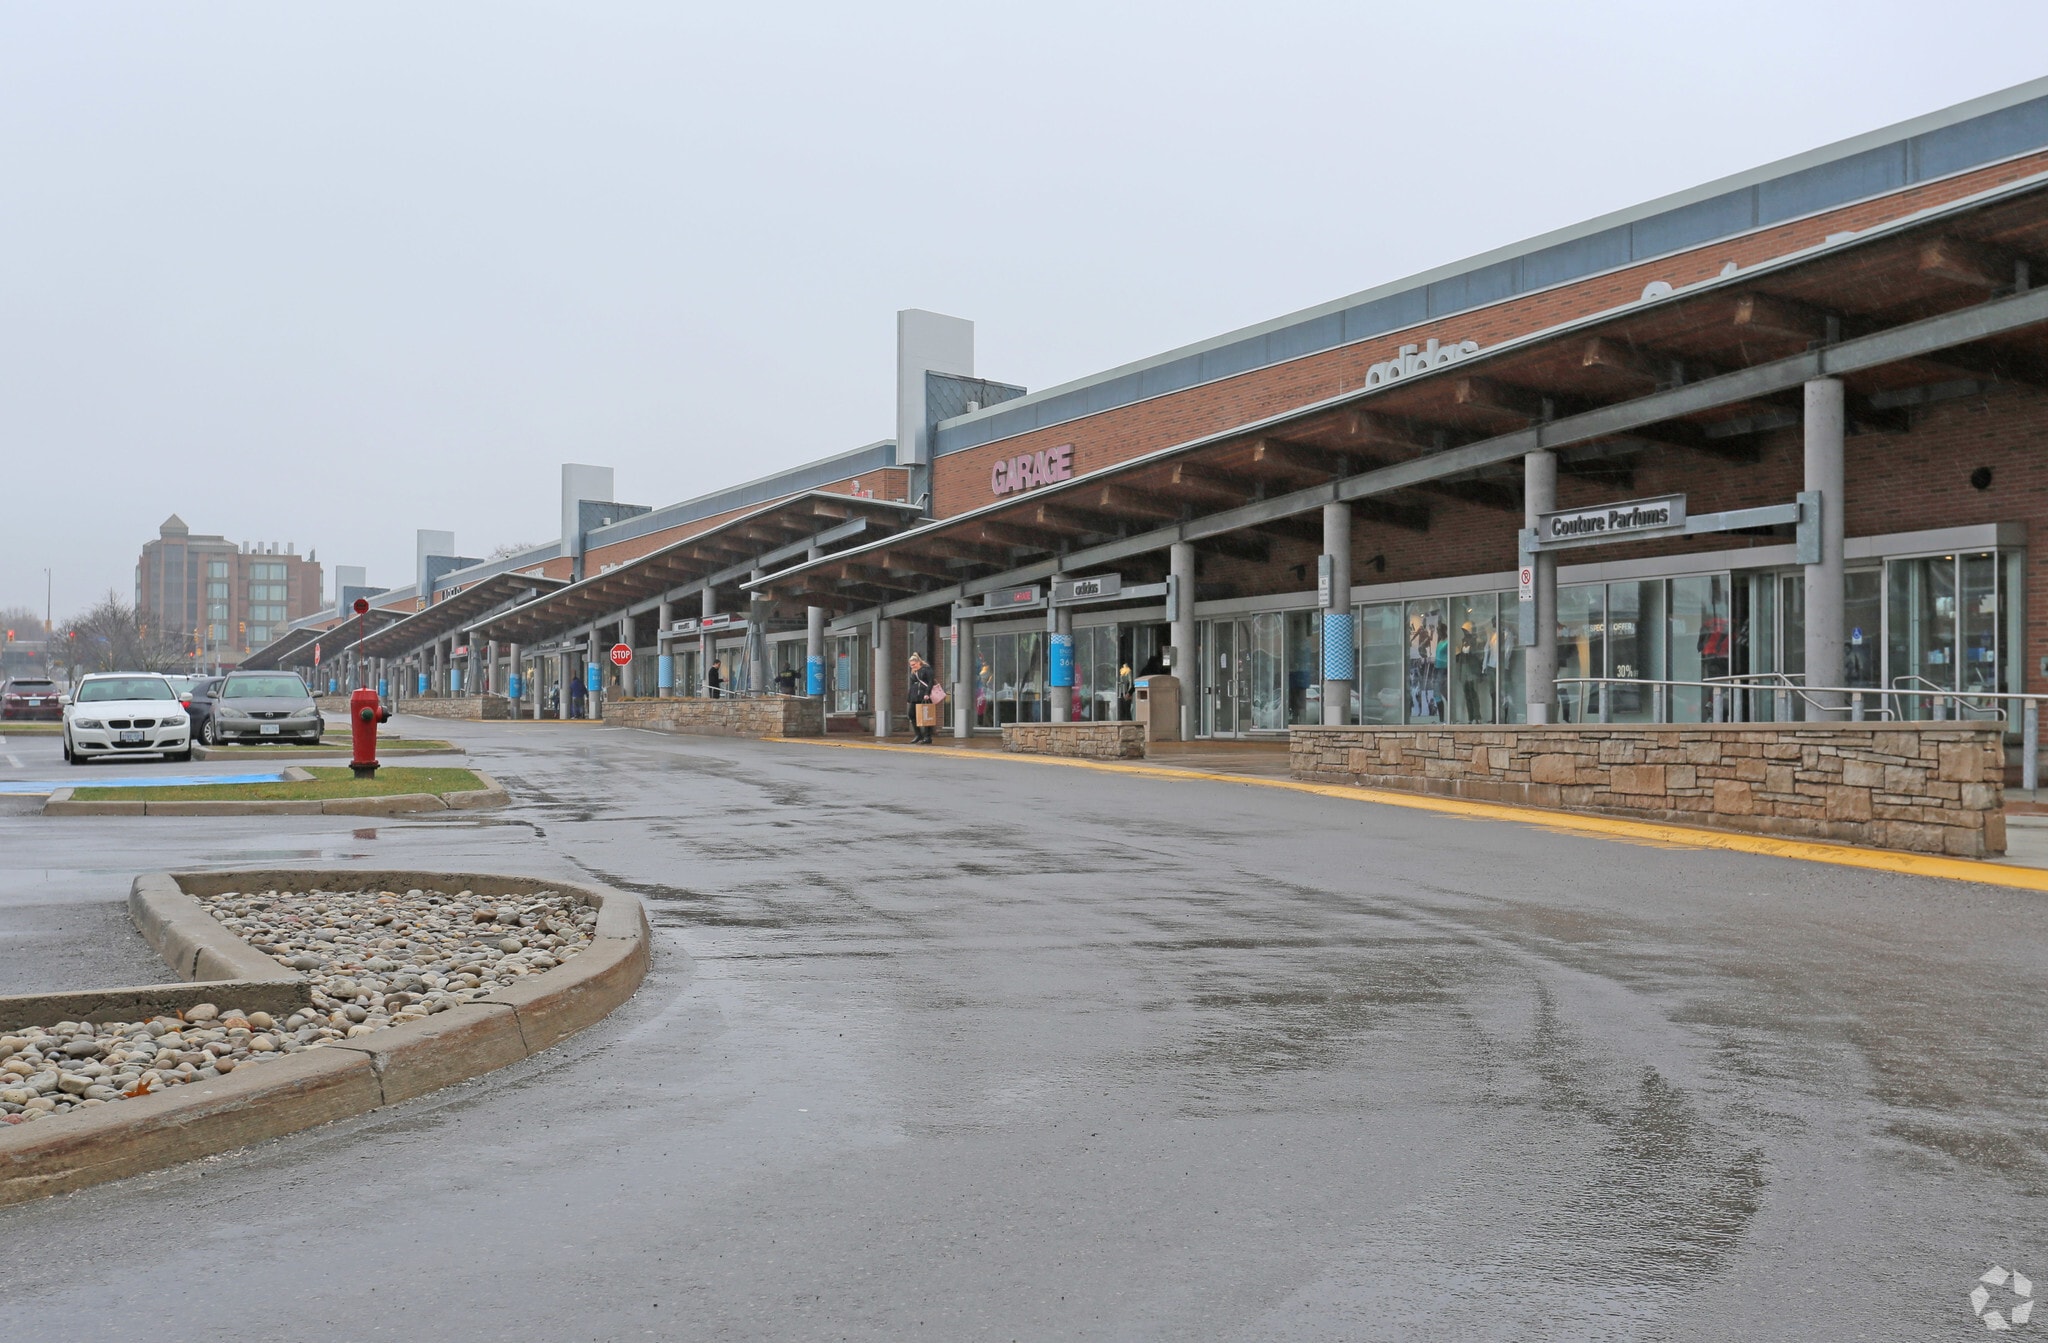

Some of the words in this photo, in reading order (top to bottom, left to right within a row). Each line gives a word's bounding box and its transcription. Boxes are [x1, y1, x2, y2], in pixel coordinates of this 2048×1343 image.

[1365, 338, 1479, 388] adidas
[991, 443, 1074, 496] GARAGE
[1551, 514, 1605, 536] Couture
[1608, 507, 1668, 529] Parfums
[1074, 581, 1099, 596] adidas
[612, 650, 631, 659] STOP
[1616, 664, 1633, 678] 30%
